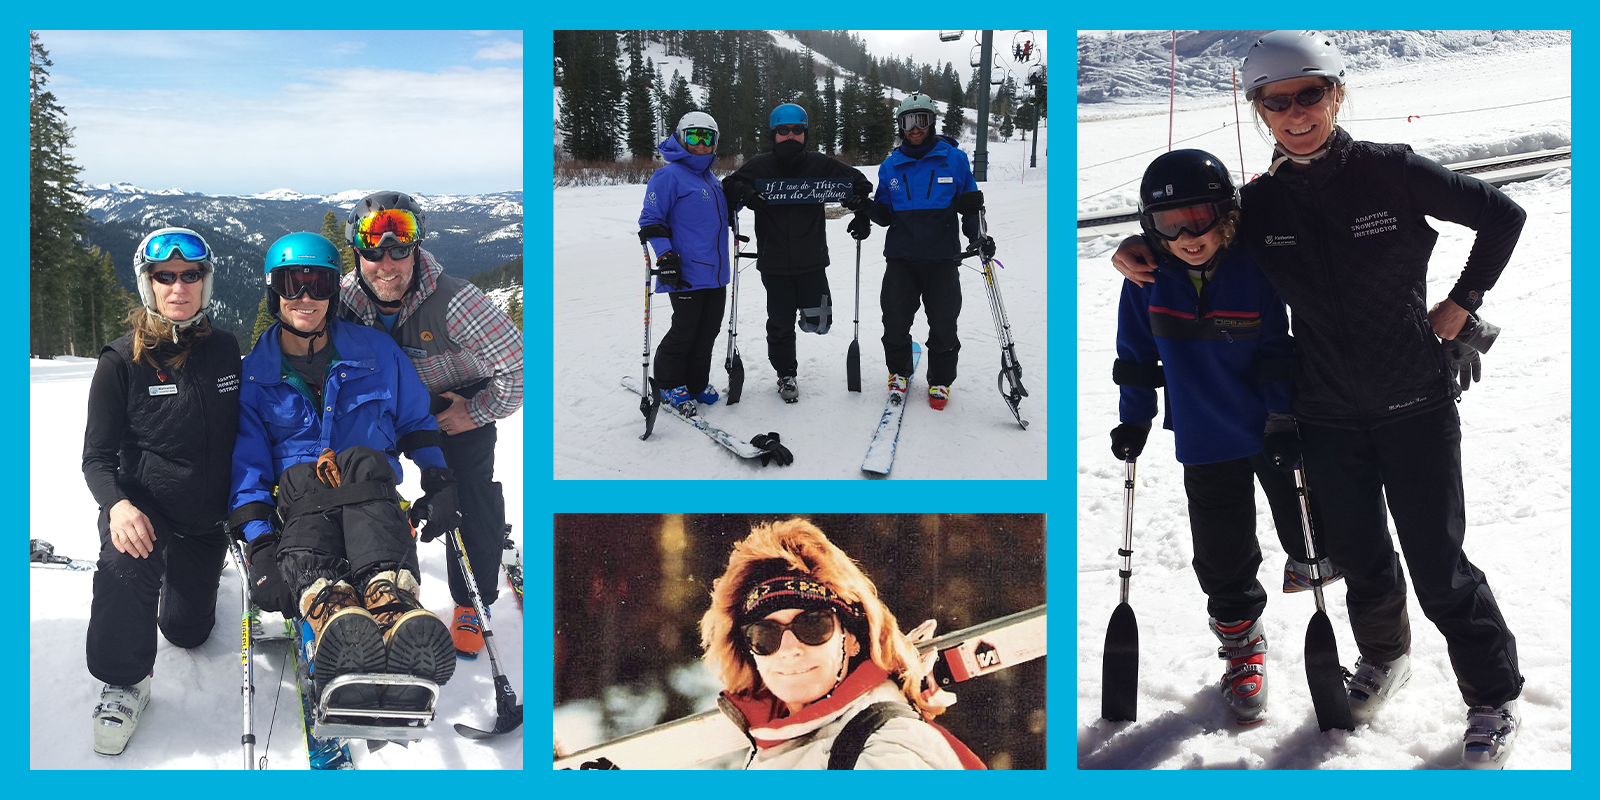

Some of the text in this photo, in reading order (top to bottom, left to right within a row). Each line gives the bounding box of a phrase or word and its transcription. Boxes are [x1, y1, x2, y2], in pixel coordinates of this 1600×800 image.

[765, 181, 776, 195] If
[777, 181, 785, 191] I
[800, 180, 810, 190] do
[814, 180, 836, 189] This
[790, 189, 803, 199] do
[803, 188, 847, 203] Anything
[1350, 217, 1398, 231] SNOWSPORTS
[1355, 211, 1389, 223] ADAPTIVE
[1353, 224, 1398, 238] INSTRUCTOR
